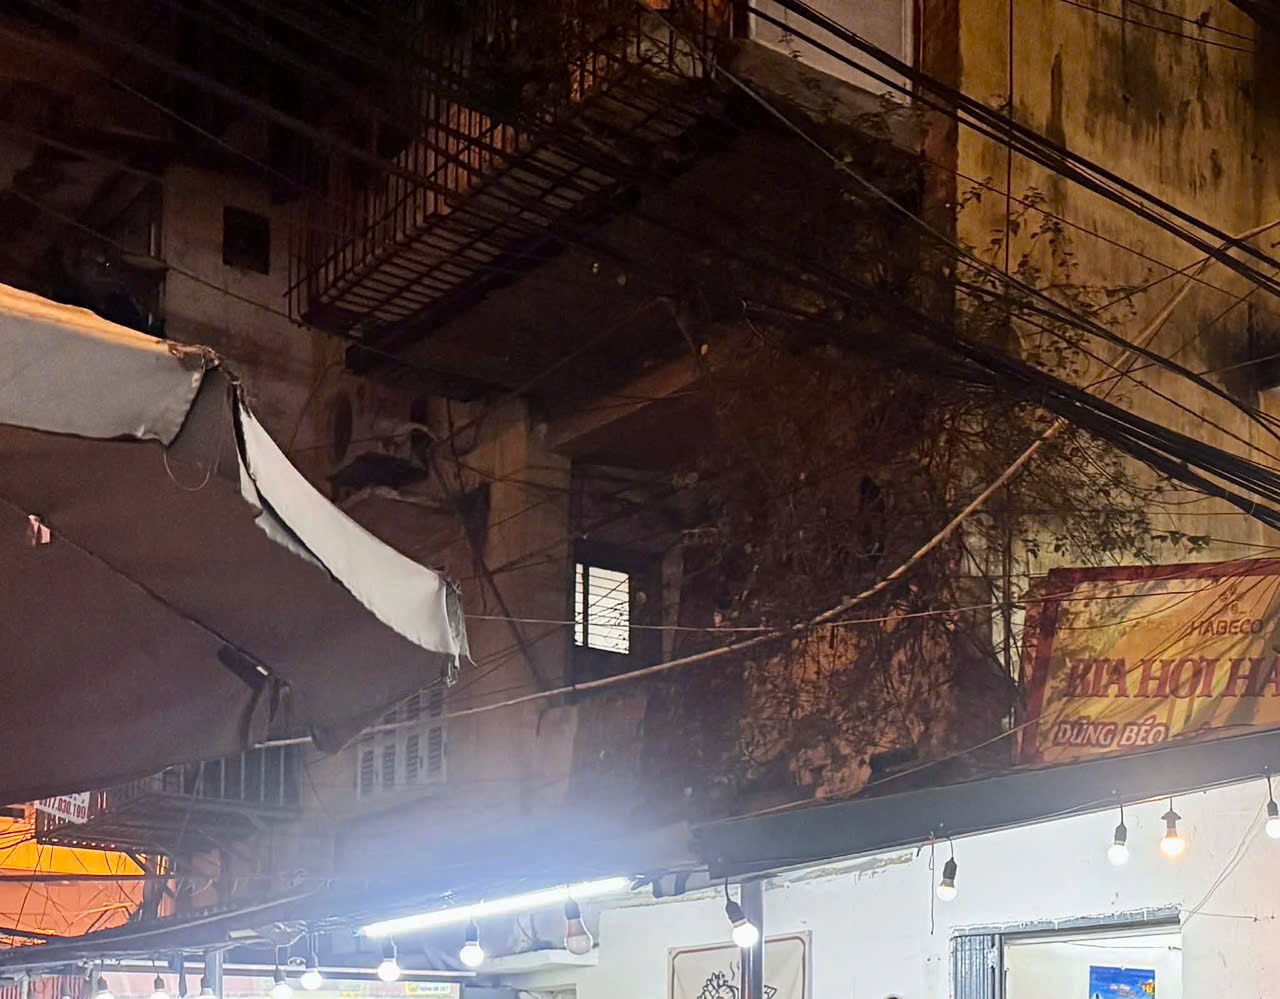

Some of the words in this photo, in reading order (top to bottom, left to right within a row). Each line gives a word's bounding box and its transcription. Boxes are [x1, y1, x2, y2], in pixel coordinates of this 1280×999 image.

[1190, 618, 1263, 636] HABECO
[1067, 655, 1129, 699] BIA
[1119, 713, 1168, 746] BÉO
